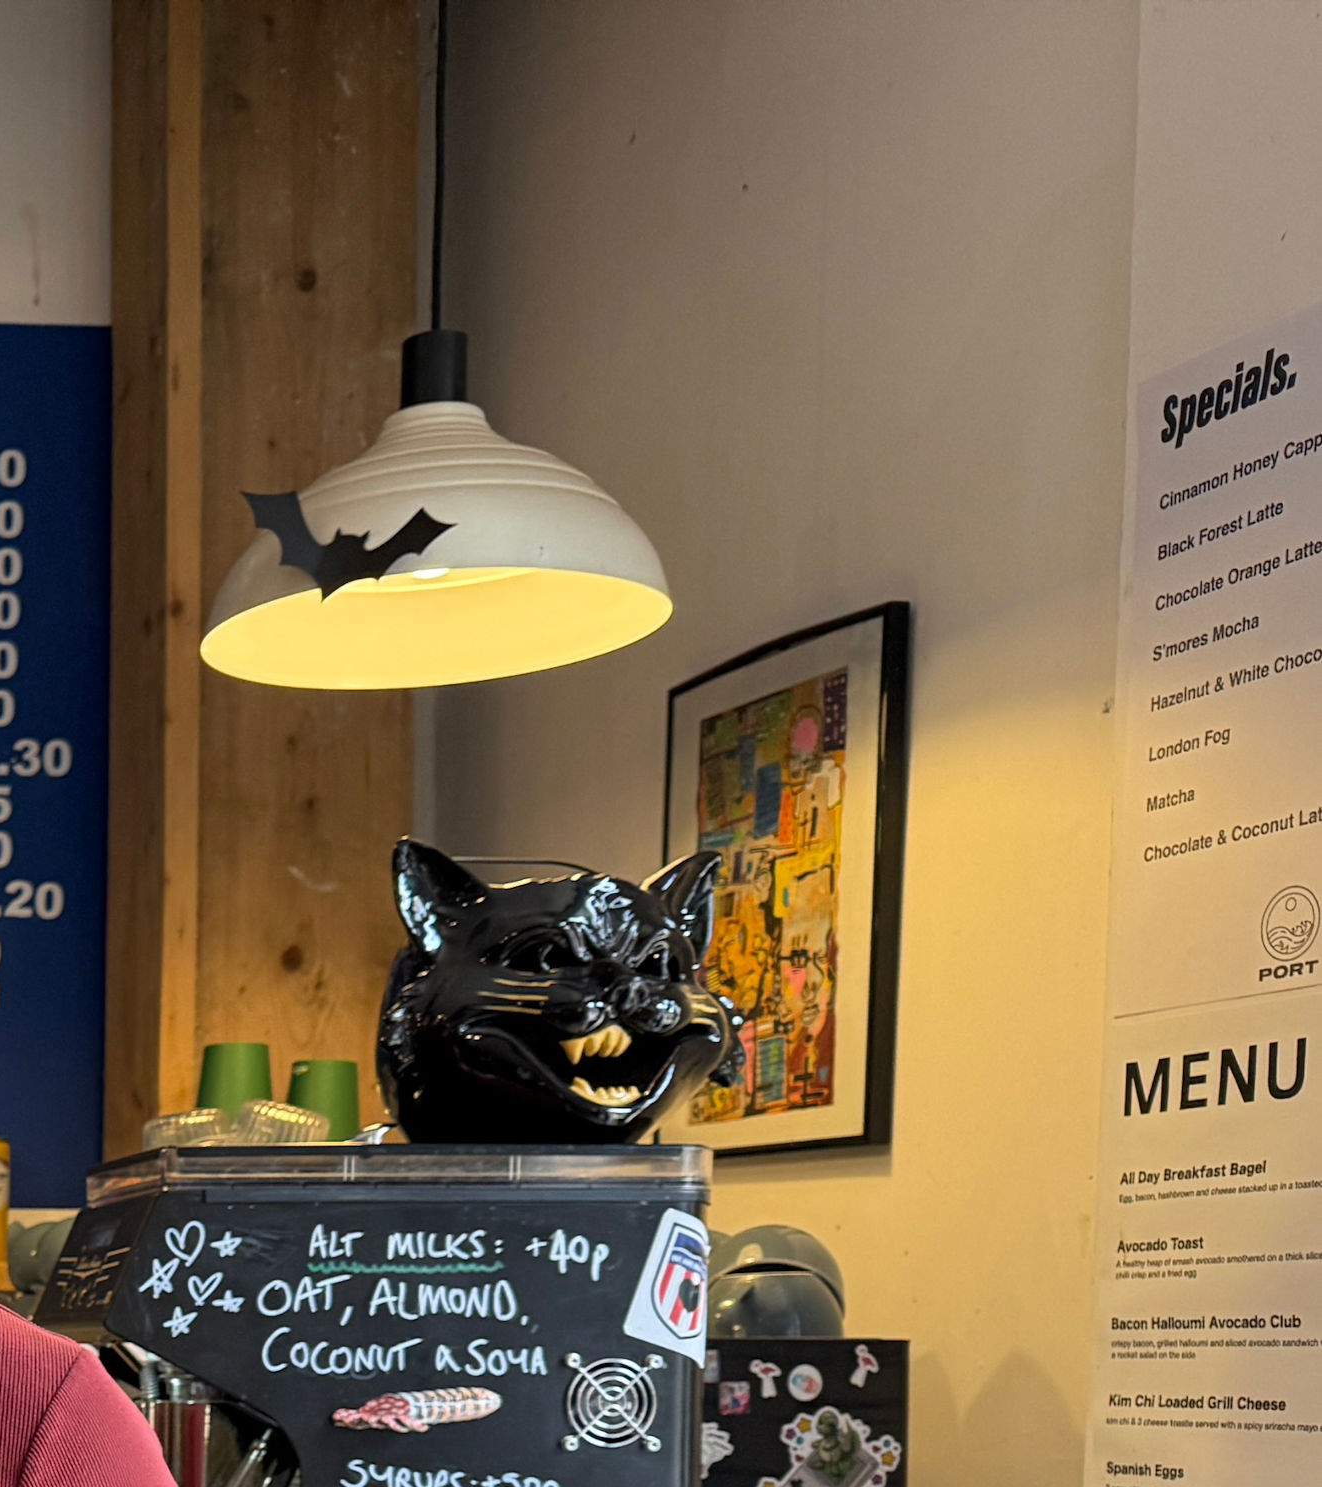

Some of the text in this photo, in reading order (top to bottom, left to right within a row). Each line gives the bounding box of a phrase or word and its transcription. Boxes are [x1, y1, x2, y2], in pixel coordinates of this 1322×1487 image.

[1161, 348, 1297, 449] Specials.
[1160, 472, 1228, 510] Cinnamon
[1233, 451, 1279, 480] Honey
[1158, 502, 1284, 561] Black Forest Latte
[1155, 540, 1322, 611] Chocolate Orange Latte
[1152, 615, 1259, 662] S'mores Mocha
[1150, 681, 1211, 712] Hazelnut
[1214, 677, 1224, 692] &
[1229, 664, 1270, 687] White
[1149, 728, 1231, 762] London Fog
[1146, 788, 1195, 813] Matcha
[1144, 834, 1213, 863] Chocolate
[1217, 829, 1227, 845] &
[1231, 813, 1294, 842] Coconut
[1258, 959, 1319, 982] PORT
[1123, 1037, 1307, 1117] MENU
[1120, 1160, 1267, 1185] All Day Breakfast Bagel
[307, 1223, 611, 1282] ALT MILKS: +40p
[1117, 1236, 1204, 1254] Avocado Toast
[256, 1274, 353, 1327] OAT,
[1111, 1315, 1301, 1330] Bacon Halloumi Avocado Club
[262, 1326, 424, 1375] COCONUT
[1108, 1394, 1286, 1411] Kim Chi Loaded Grill Cheese
[1106, 1461, 1185, 1480] Spanish Eggs
